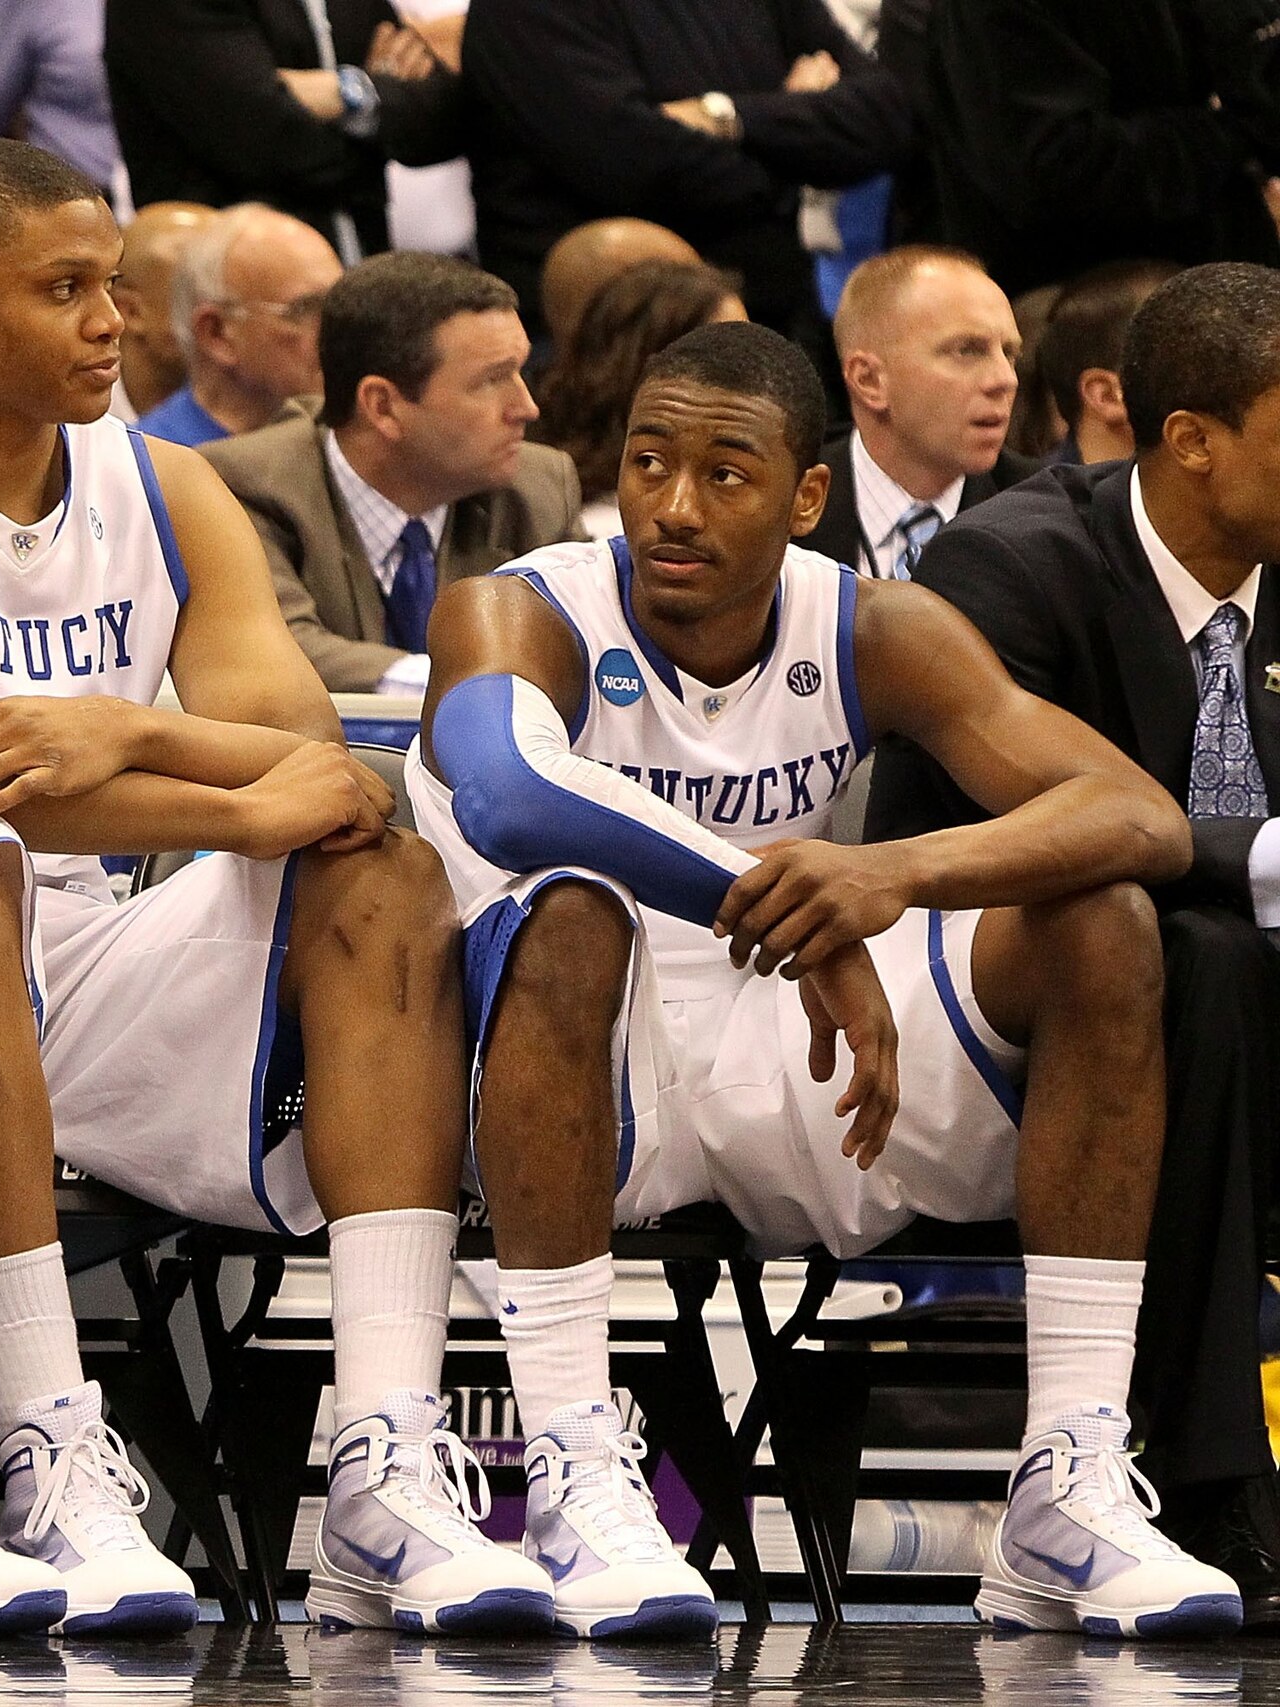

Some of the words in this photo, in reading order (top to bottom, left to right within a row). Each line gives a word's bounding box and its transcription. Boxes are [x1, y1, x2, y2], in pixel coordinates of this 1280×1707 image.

[601, 675, 639, 693] NCAA
[790, 662, 820, 694] SEC
[583, 742, 850, 827] NTUCKY
